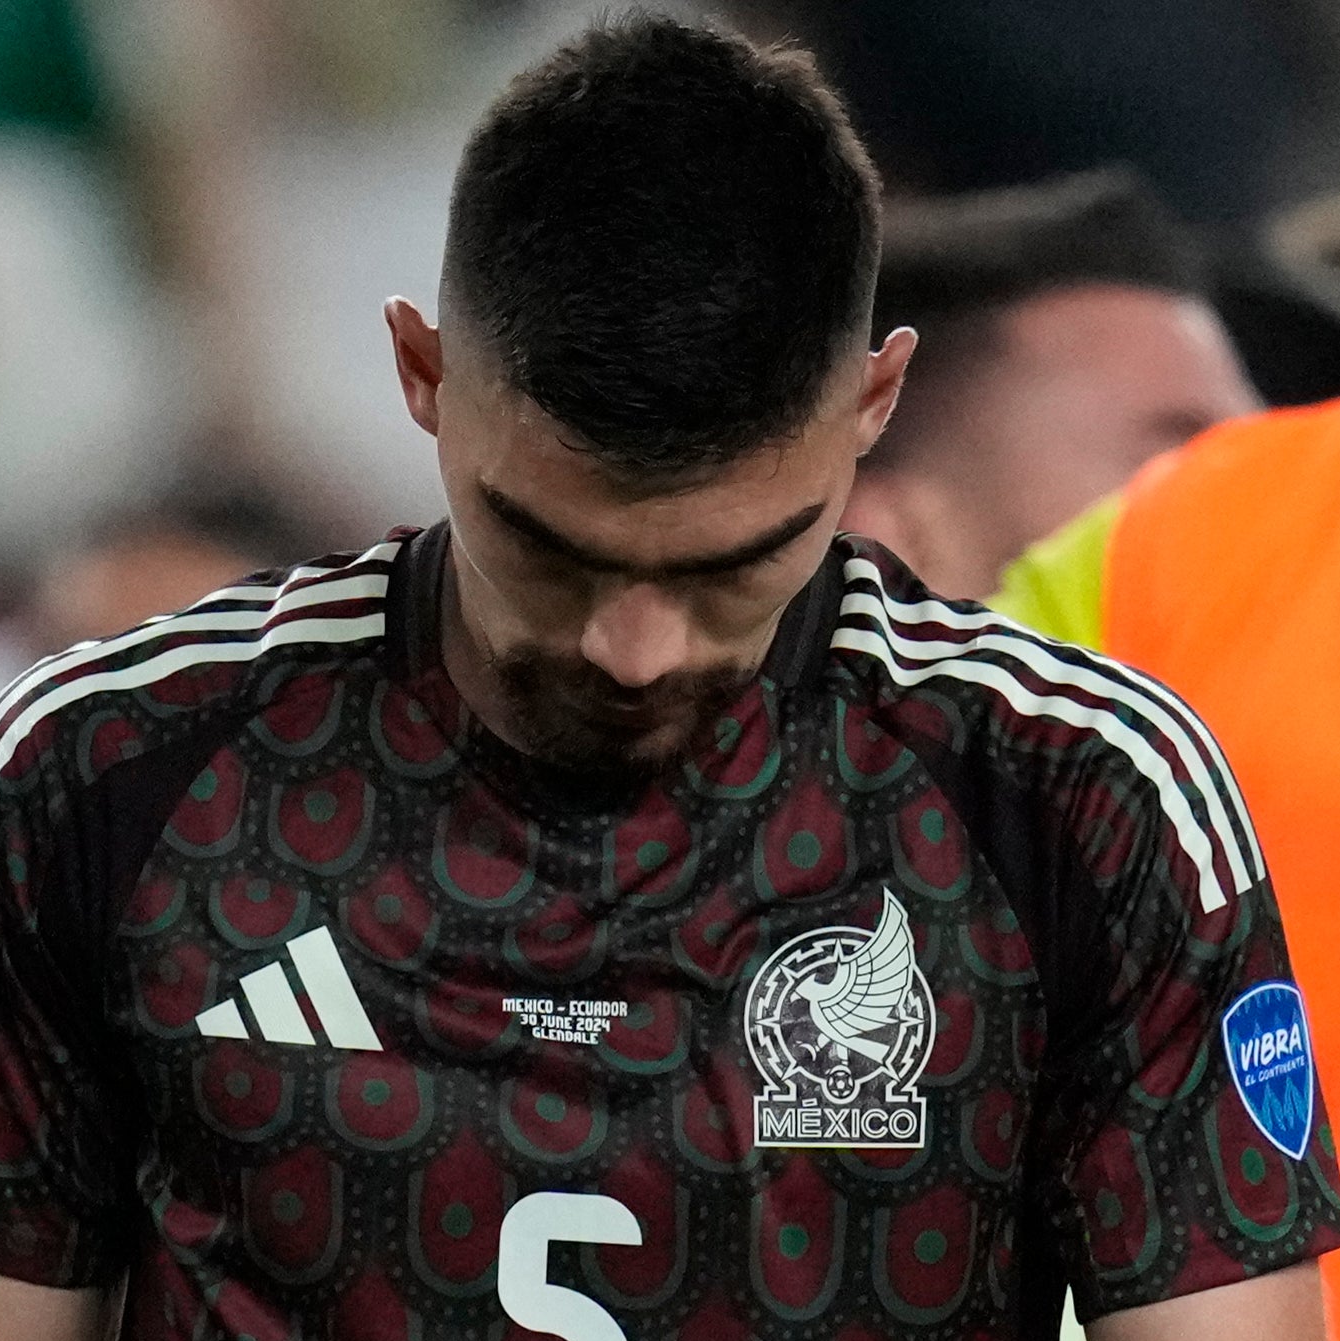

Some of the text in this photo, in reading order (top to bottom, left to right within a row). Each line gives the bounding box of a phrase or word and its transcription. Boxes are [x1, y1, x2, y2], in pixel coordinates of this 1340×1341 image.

[502, 998, 554, 1014] MEXICO
[569, 1001, 628, 1017] ECUADOR
[520, 1013, 611, 1032] 30 JUNE 2024
[532, 1027, 599, 1045] GLENDALE
[1240, 1022, 1303, 1072] VIBRA
[1244, 1073, 1256, 1087] EL
[761, 1097, 919, 1140] MÉXICO
